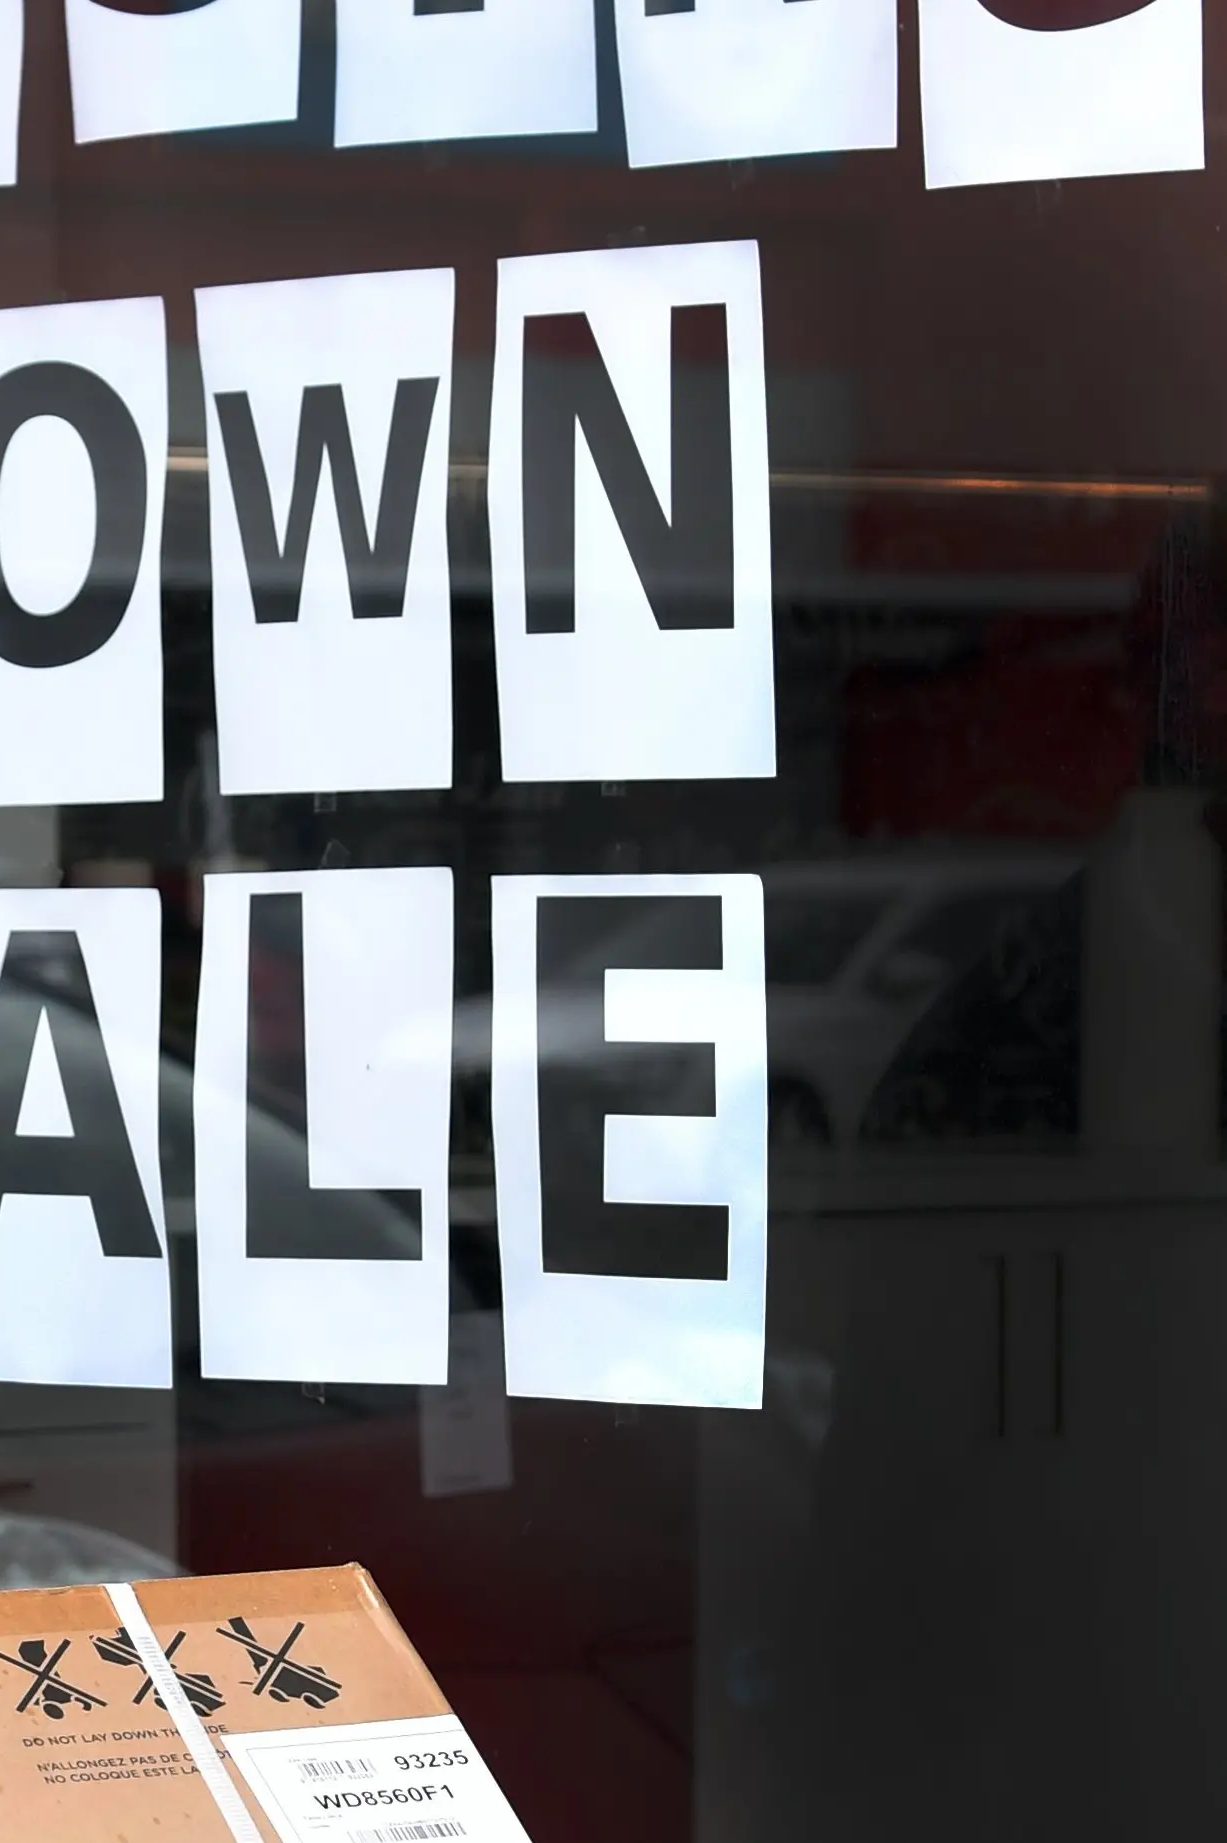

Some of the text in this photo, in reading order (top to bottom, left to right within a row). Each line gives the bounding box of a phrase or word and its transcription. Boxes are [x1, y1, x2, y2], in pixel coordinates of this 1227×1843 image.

[22, 1736, 44, 1748] DO
[48, 1734, 77, 1746] NOT
[81, 1731, 108, 1744] LAY
[112, 1728, 159, 1741] DOWN
[203, 1723, 229, 1735] IDE
[37, 1756, 125, 1773] N'ALLONGEZ
[130, 1754, 158, 1766] PAS
[159, 1753, 181, 1764] DE
[393, 1749, 470, 1771] 93235
[44, 1774, 66, 1785] NO
[70, 1769, 141, 1783] COLOQUE
[143, 1765, 178, 1777] ESTE
[313, 1784, 456, 1810] WD8560F1
